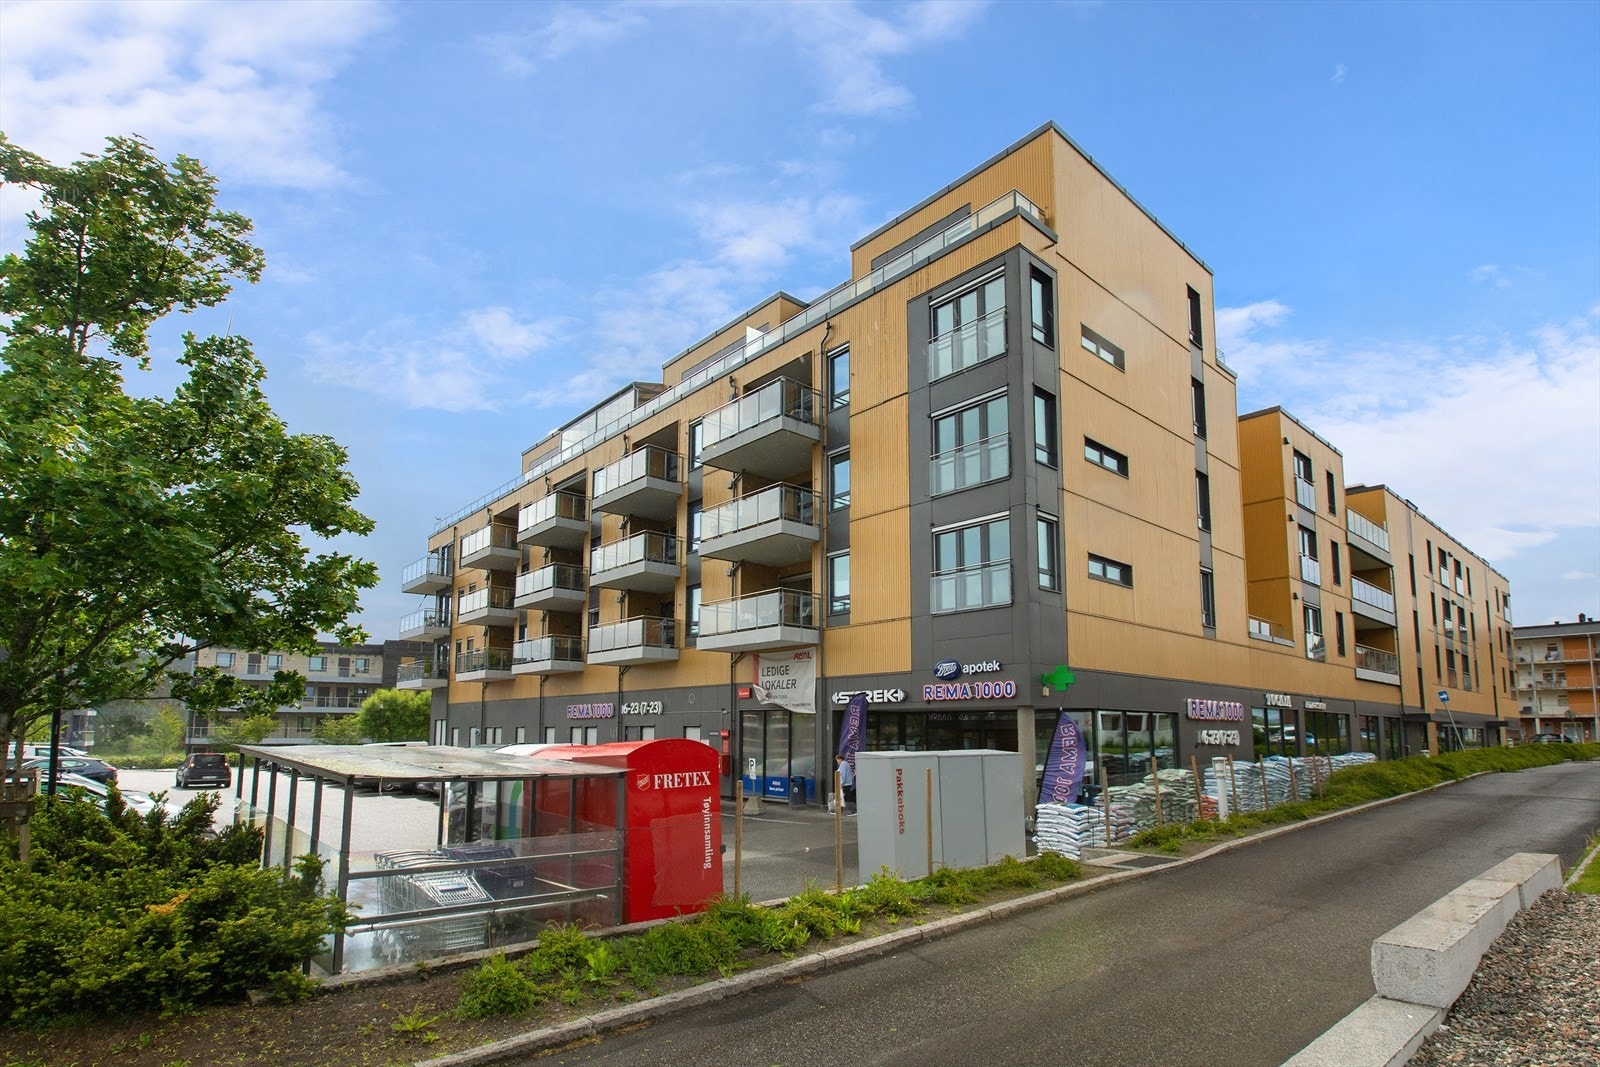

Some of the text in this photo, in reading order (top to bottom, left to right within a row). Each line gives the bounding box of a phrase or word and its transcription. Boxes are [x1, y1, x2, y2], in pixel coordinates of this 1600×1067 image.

[761, 665, 790, 677] LEDIGE
[962, 659, 1000, 675] apotek
[761, 679, 797, 691] LOKALER
[923, 680, 1016, 701] REMA 1000
[566, 703, 614, 719] REMA 1000
[640, 700, 663, 715] (7-23)
[1188, 699, 1244, 721] REMA 1000
[749, 760, 754, 770] P
[653, 770, 711, 789] FRETEX
[896, 768, 905, 835] Pakkeboks
[702, 797, 713, 870] Tøyinnsamling
